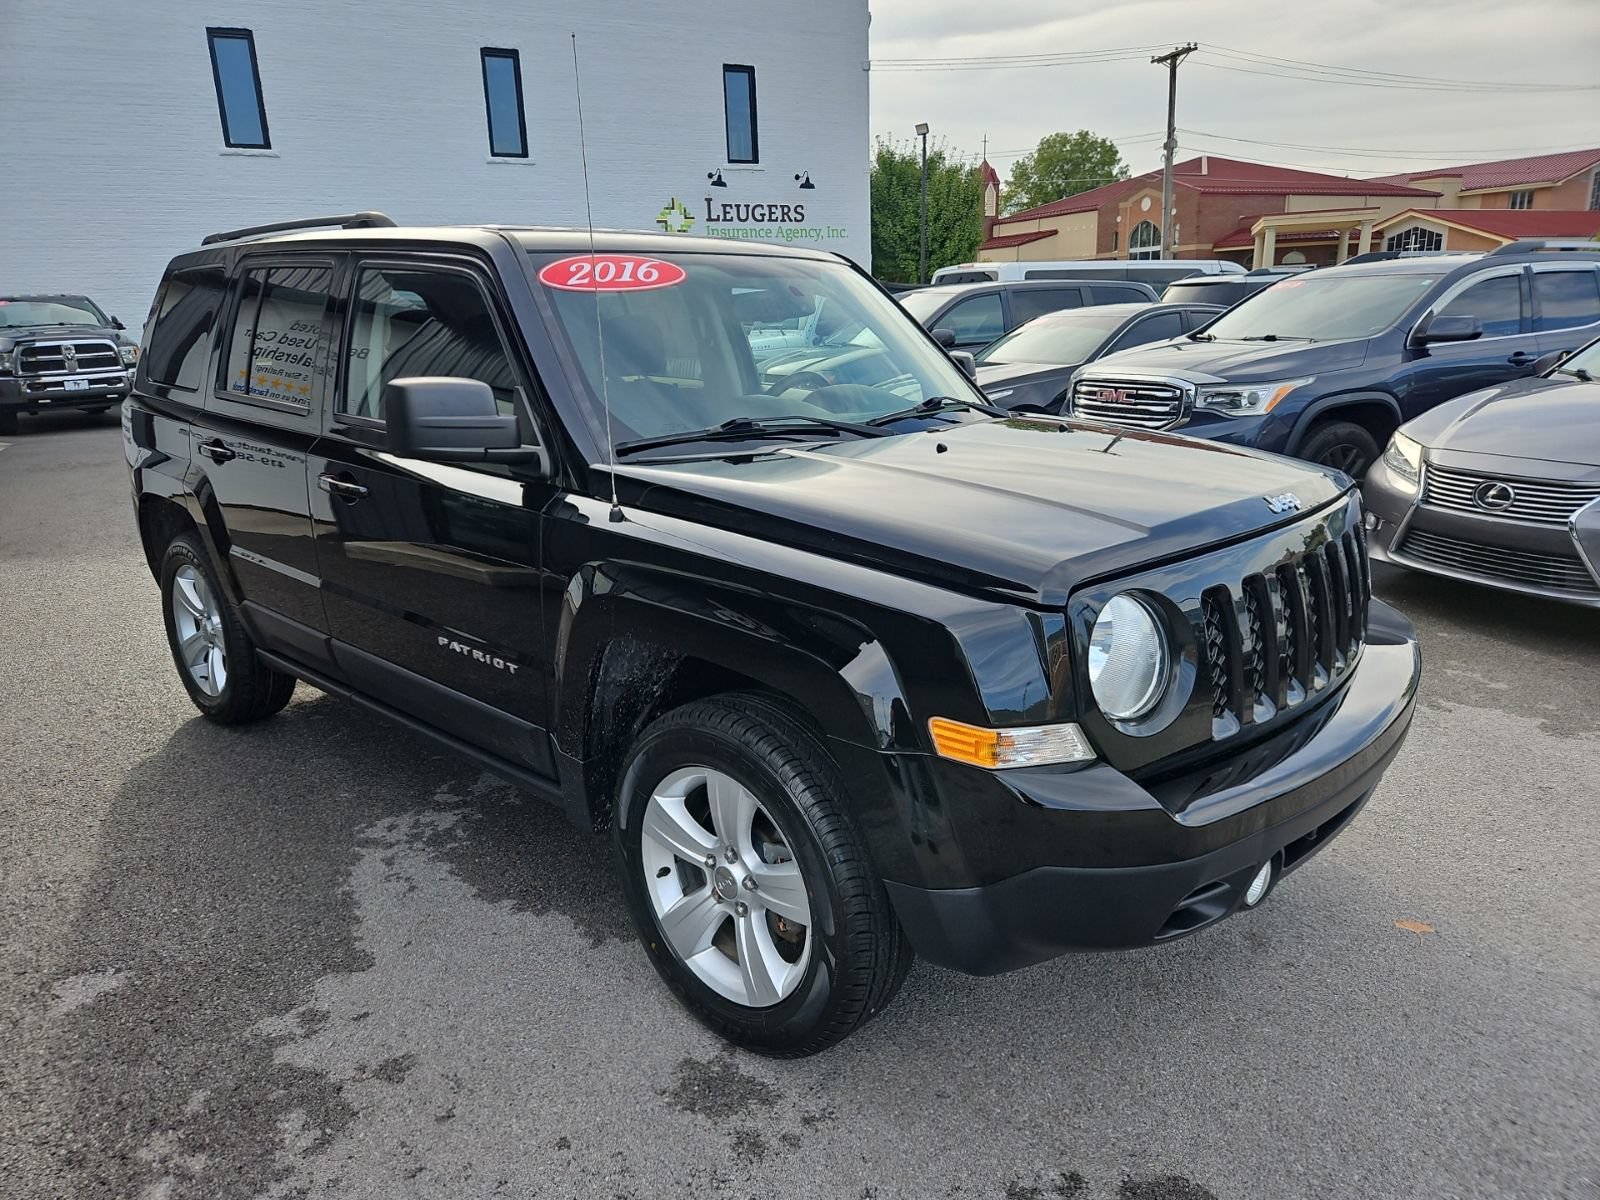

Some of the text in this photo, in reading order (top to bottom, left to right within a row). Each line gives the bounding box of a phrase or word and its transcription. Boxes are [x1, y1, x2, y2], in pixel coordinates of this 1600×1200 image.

[706, 225, 849, 242] Insurance Agency, Inc.
[566, 261, 660, 285] 2016
[1096, 388, 1136, 404] GMC
[1262, 492, 1302, 514] Jeep
[437, 635, 520, 675] PATRIOT
